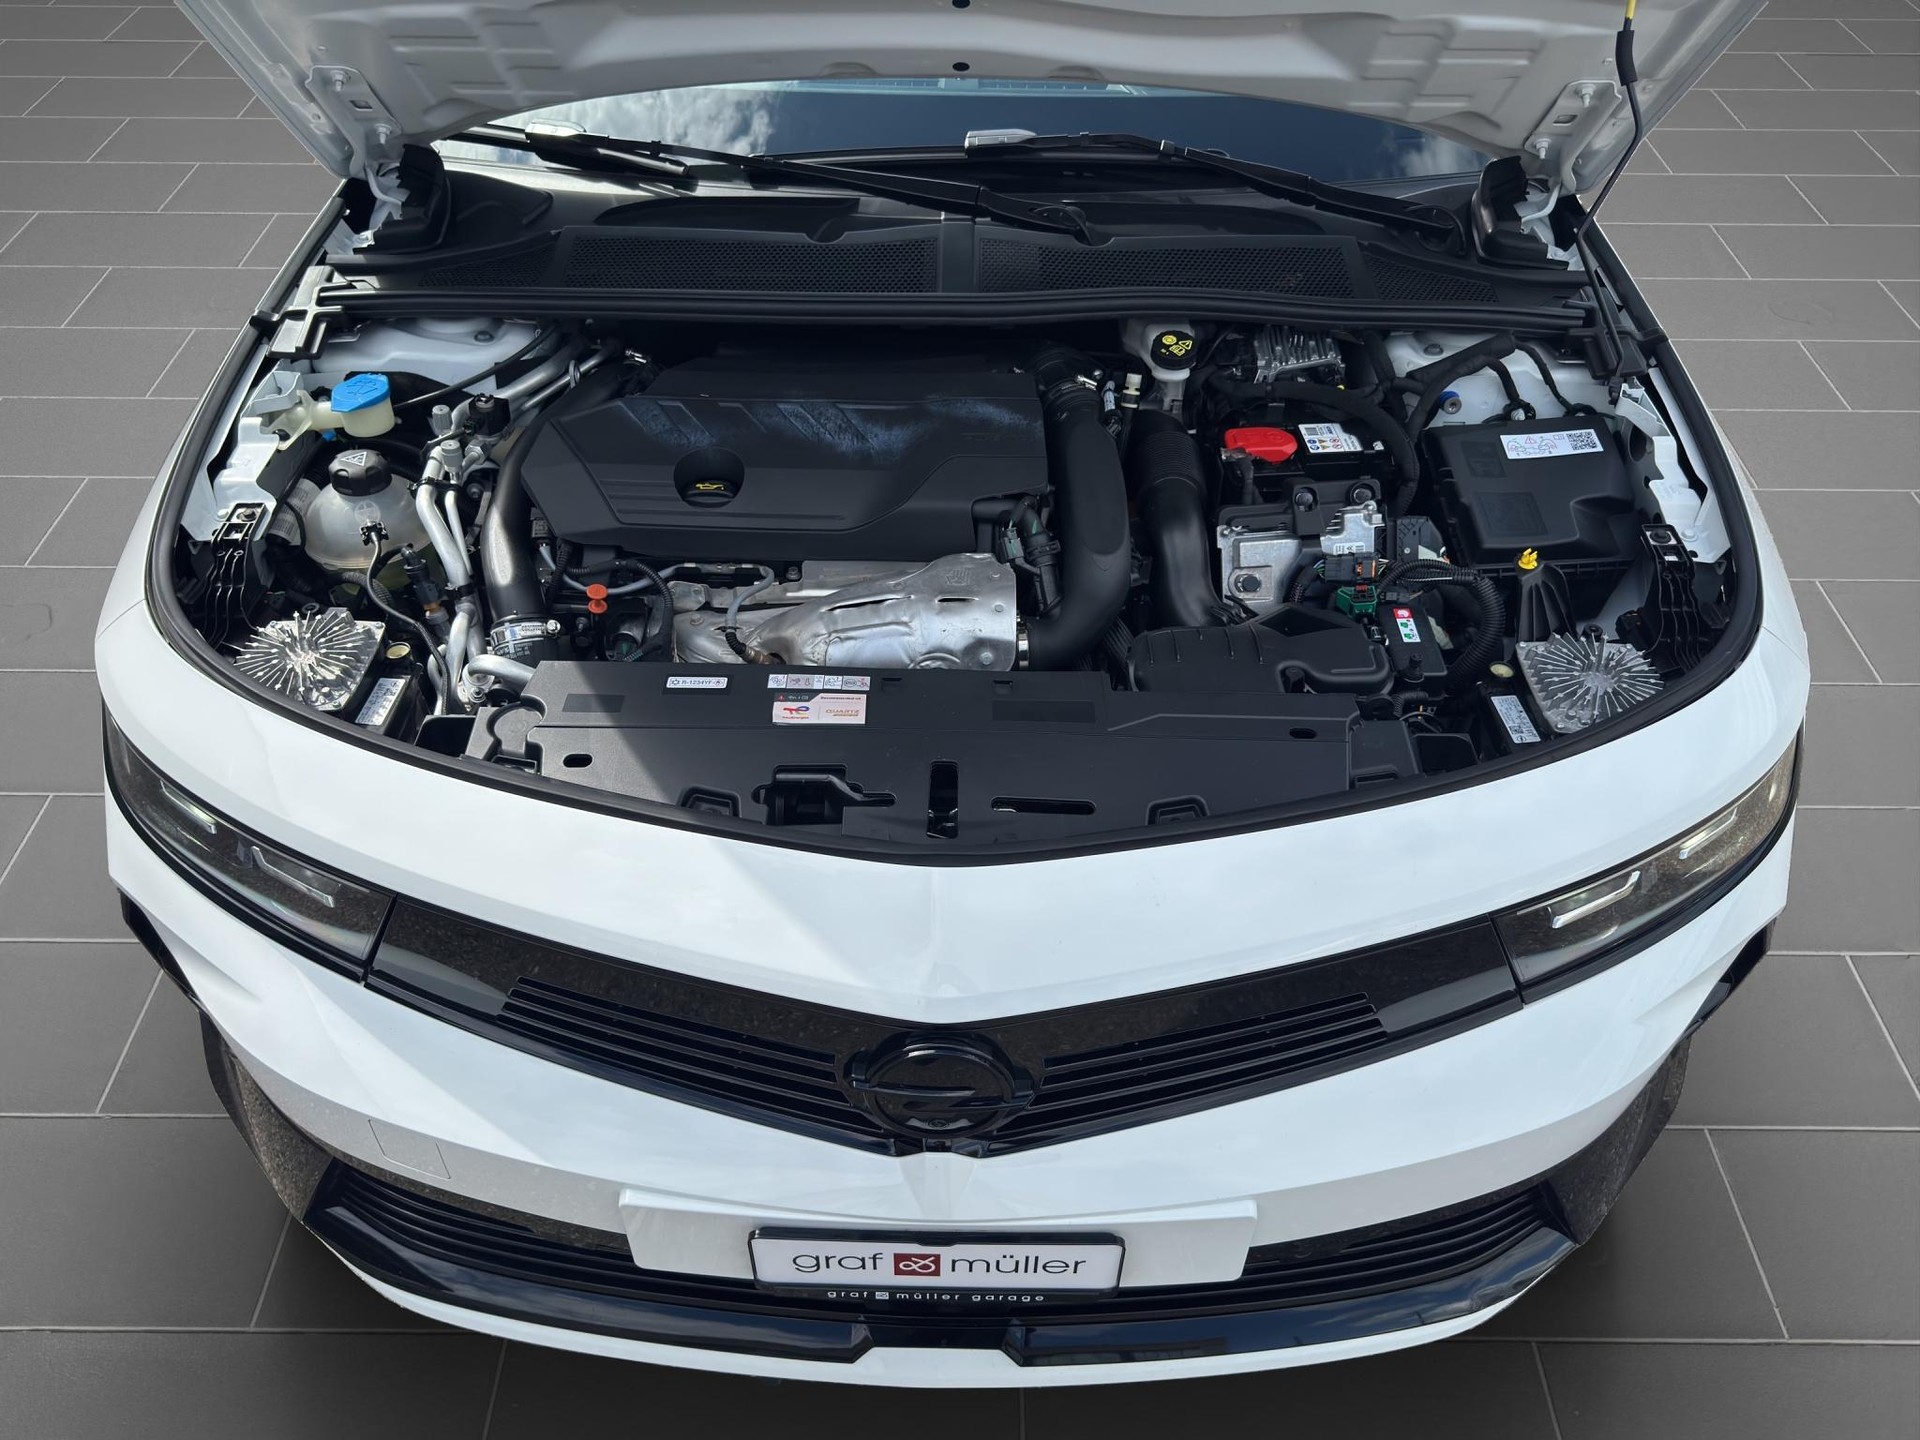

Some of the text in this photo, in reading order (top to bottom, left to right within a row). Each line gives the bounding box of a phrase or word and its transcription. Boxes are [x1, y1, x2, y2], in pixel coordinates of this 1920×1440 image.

[792, 1252, 1087, 1275] graf müller
[827, 1290, 1044, 1303] graf müller garage
